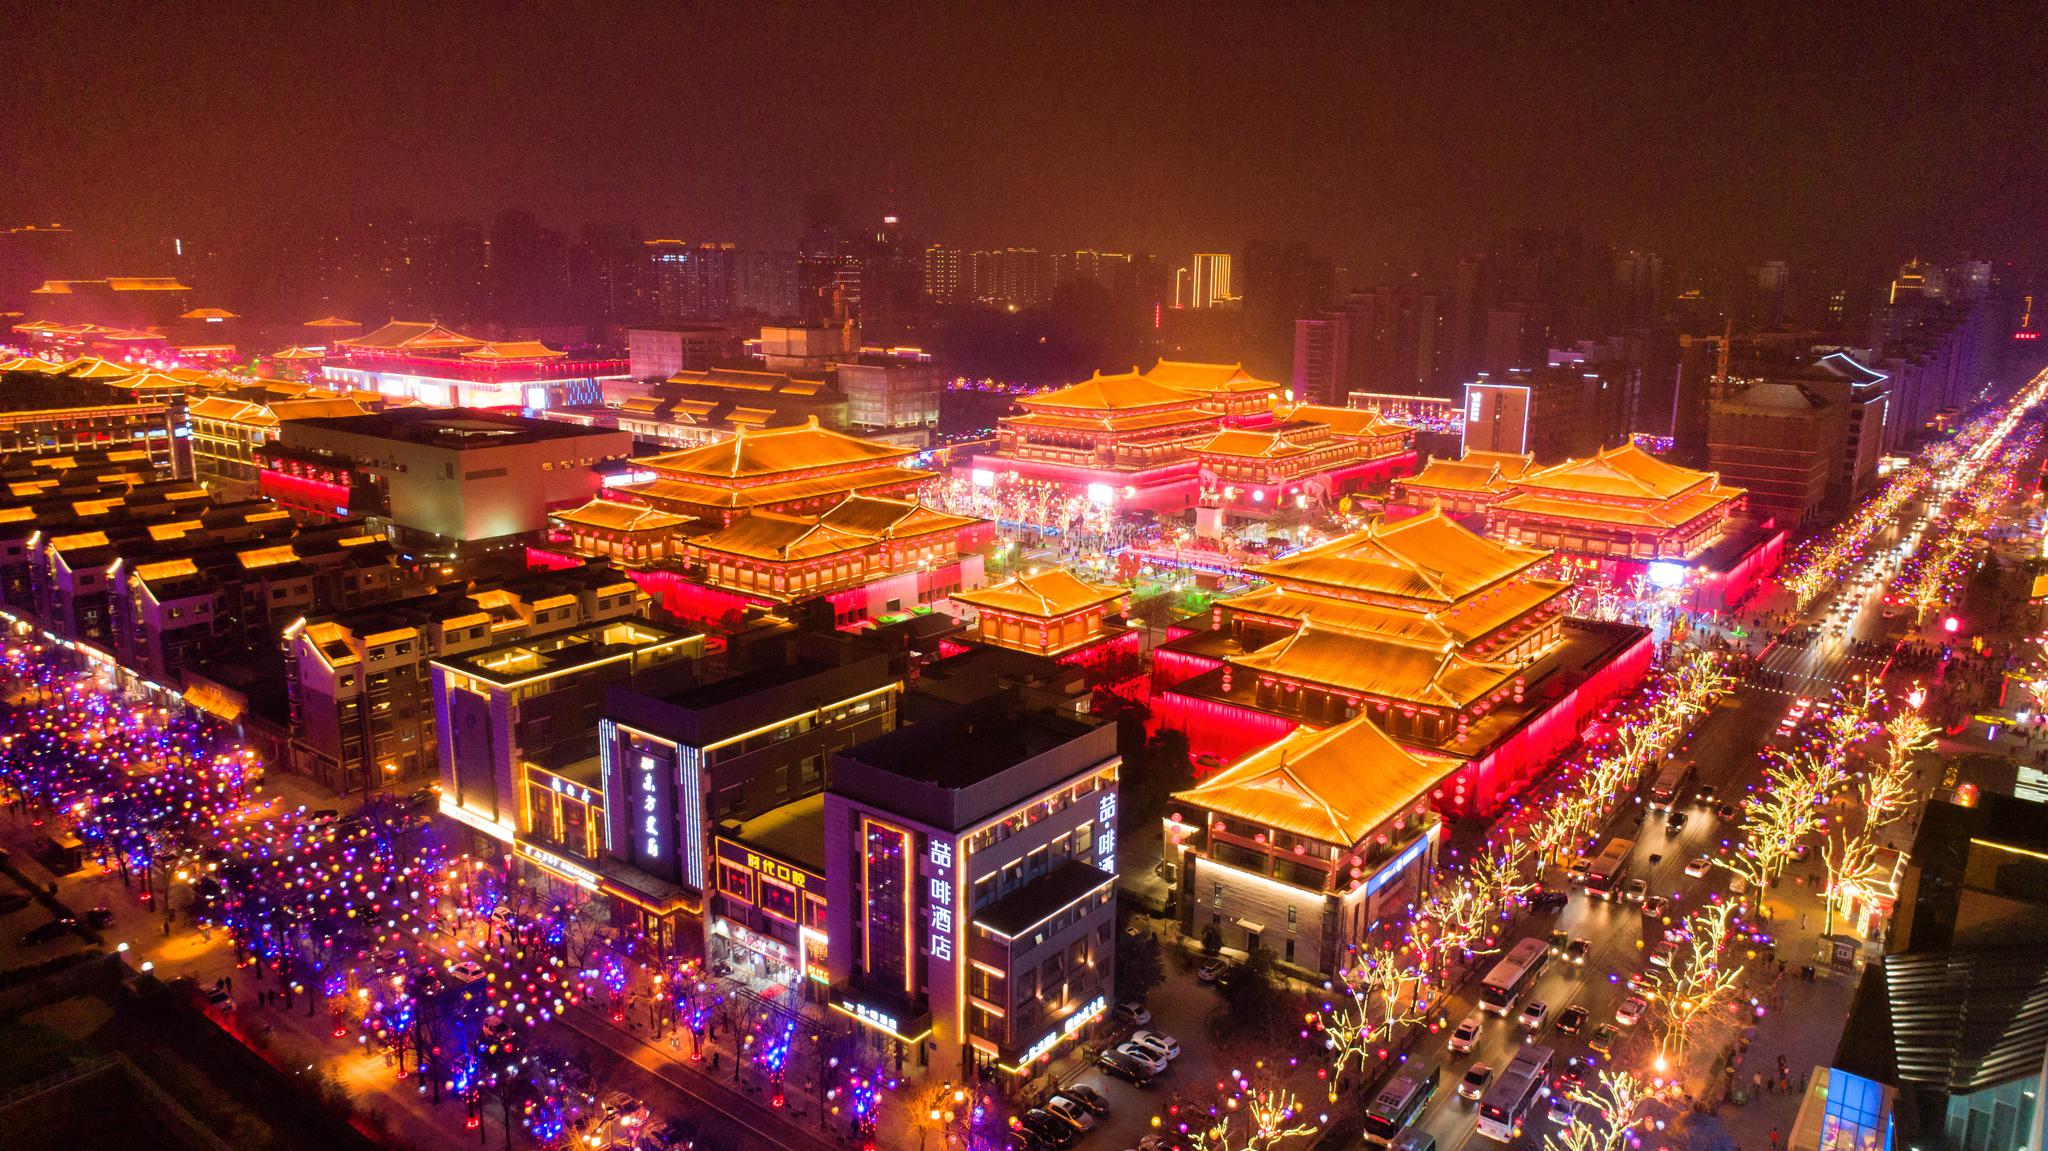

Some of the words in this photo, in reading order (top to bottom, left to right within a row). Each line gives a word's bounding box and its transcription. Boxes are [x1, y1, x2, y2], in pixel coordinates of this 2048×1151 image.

[747, 853, 806, 888] 时代口腔
[930, 839, 952, 961] 喆·啡酒店
